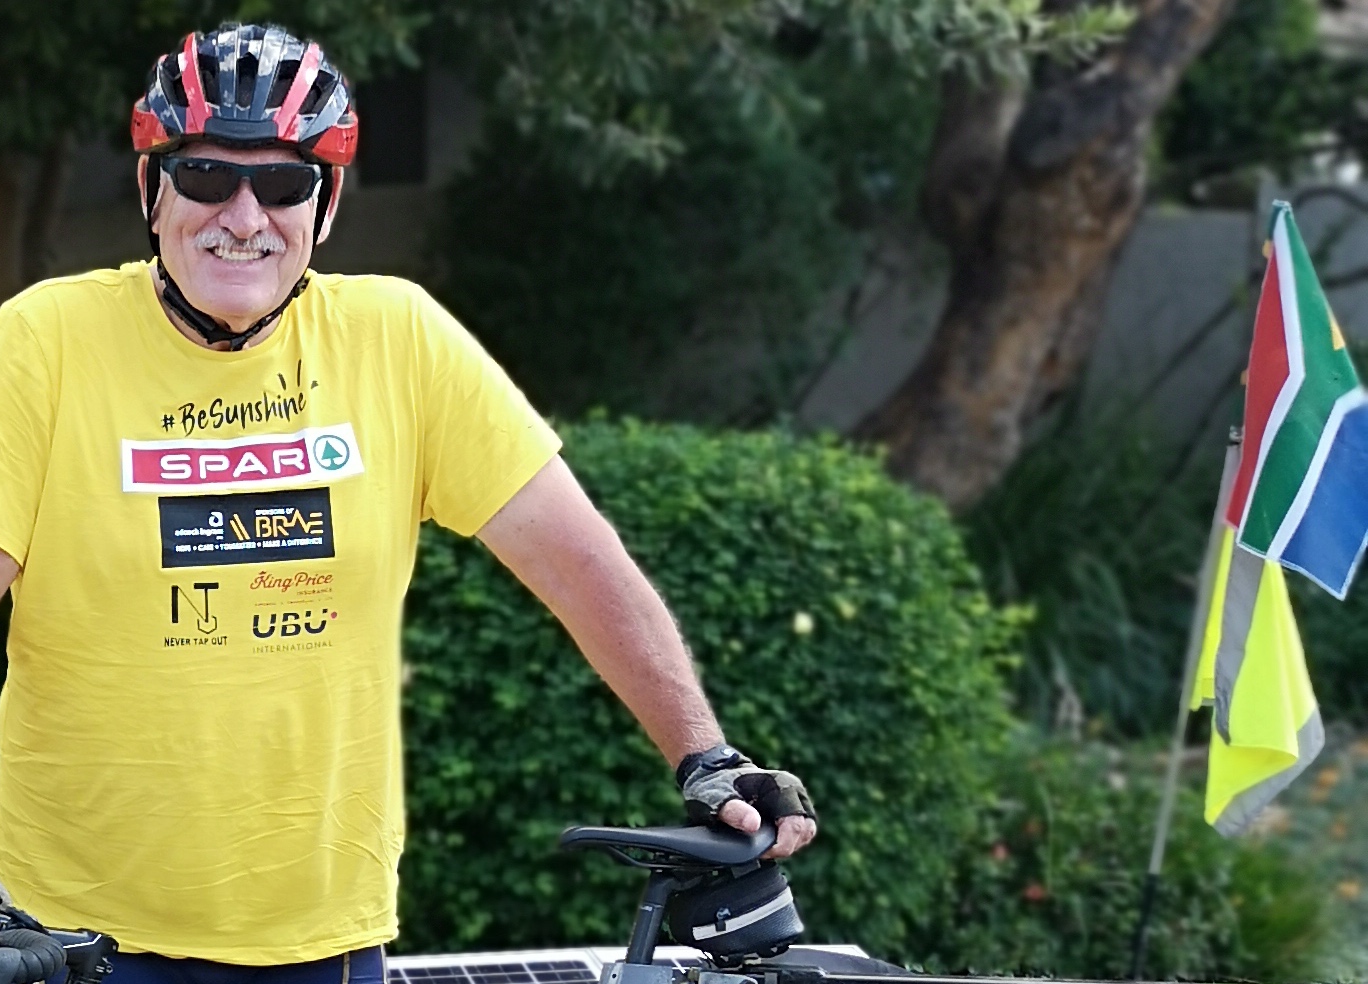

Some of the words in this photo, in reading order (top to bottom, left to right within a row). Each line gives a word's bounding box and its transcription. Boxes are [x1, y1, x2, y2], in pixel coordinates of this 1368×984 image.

[161, 391, 308, 437] #BeSunshine
[159, 447, 307, 481] SPAR
[250, 571, 293, 593] King
[294, 571, 334, 587] Price
[164, 637, 191, 648] NEVER
[193, 637, 209, 646] TAP
[211, 636, 228, 647] OUT
[252, 640, 334, 654] INTERNATIONAL
